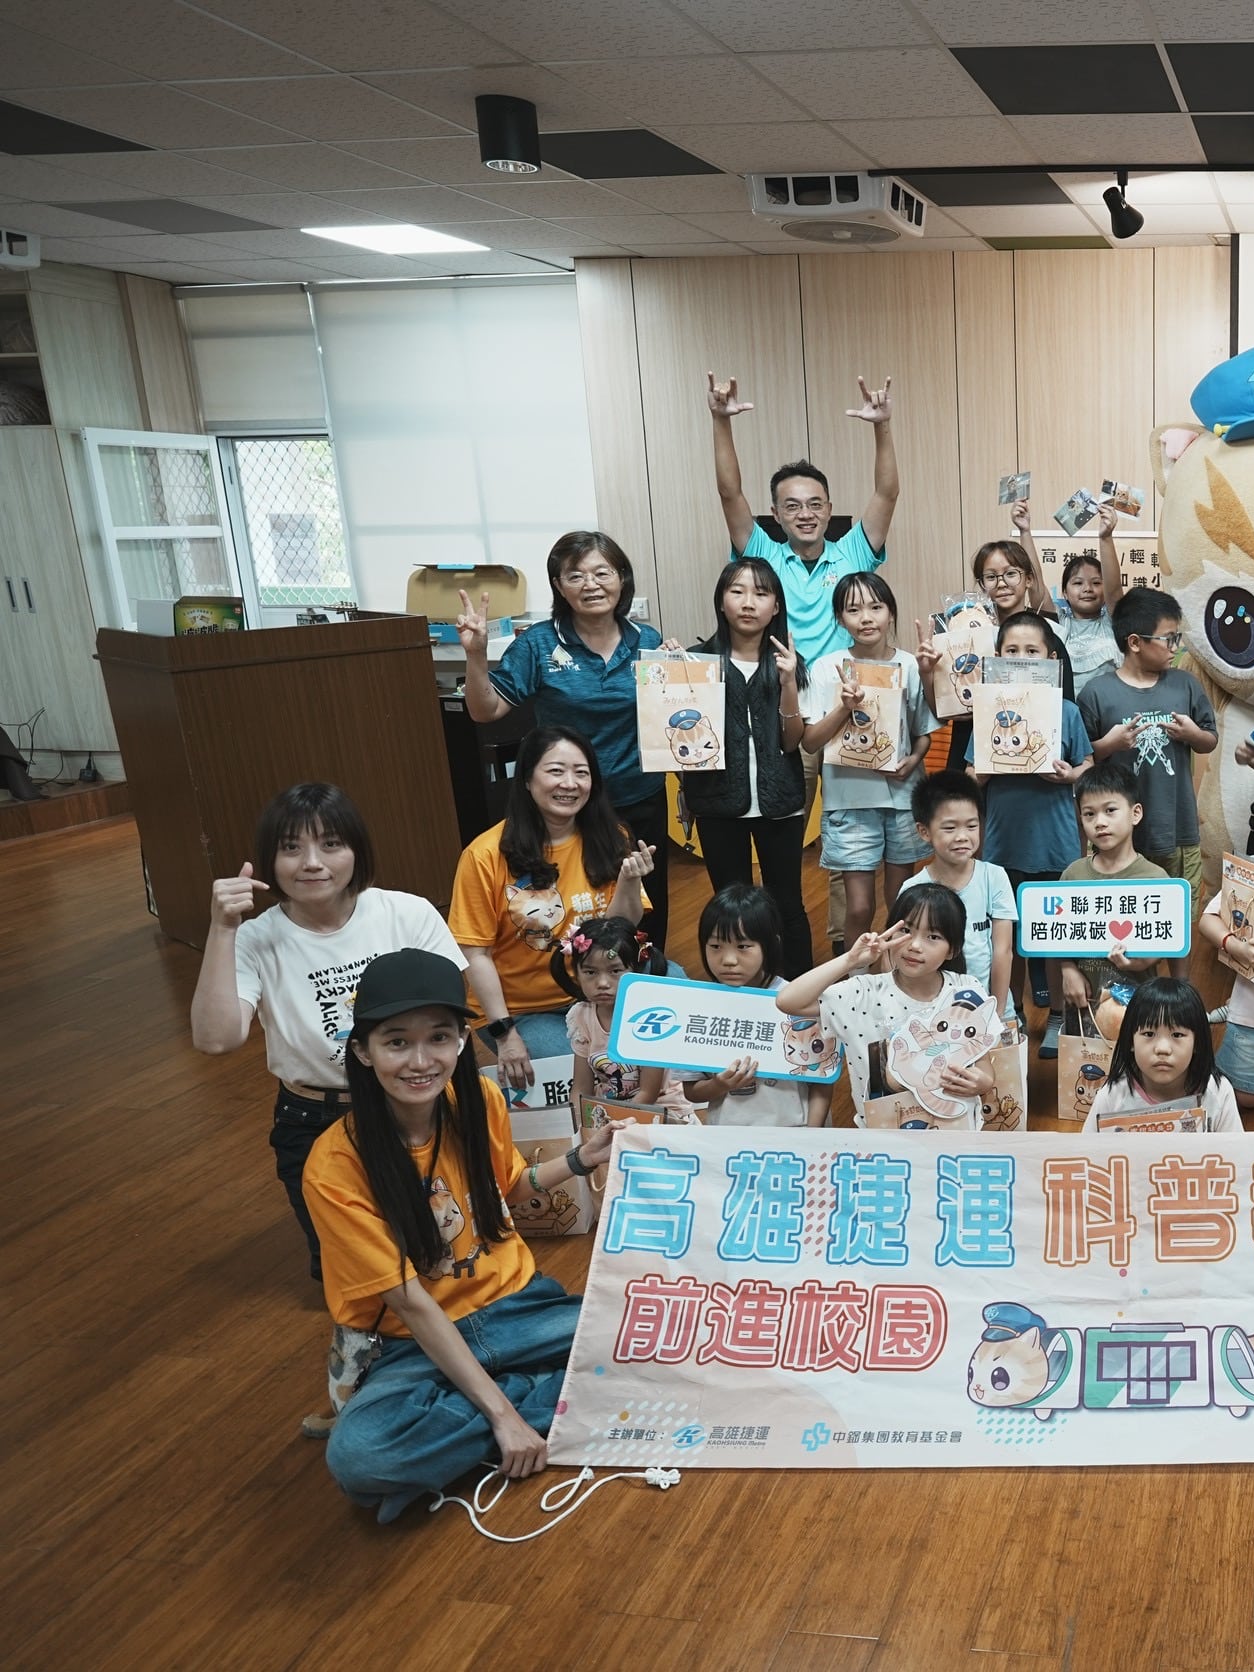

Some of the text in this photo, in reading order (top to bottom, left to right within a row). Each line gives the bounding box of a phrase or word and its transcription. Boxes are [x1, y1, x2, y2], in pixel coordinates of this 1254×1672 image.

[1070, 894, 1161, 915] 聯邦銀行
[1030, 920, 1173, 941] 陪你減碳 地球
[684, 1013, 777, 1043] 高雄捷運
[683, 1035, 773, 1052] KAOHSIUNG Metro
[612, 1272, 949, 1374] 前進校園
[708, 1425, 771, 1441] 高雄捷運
[832, 1430, 963, 1444] 中鋼集團教育基金會
